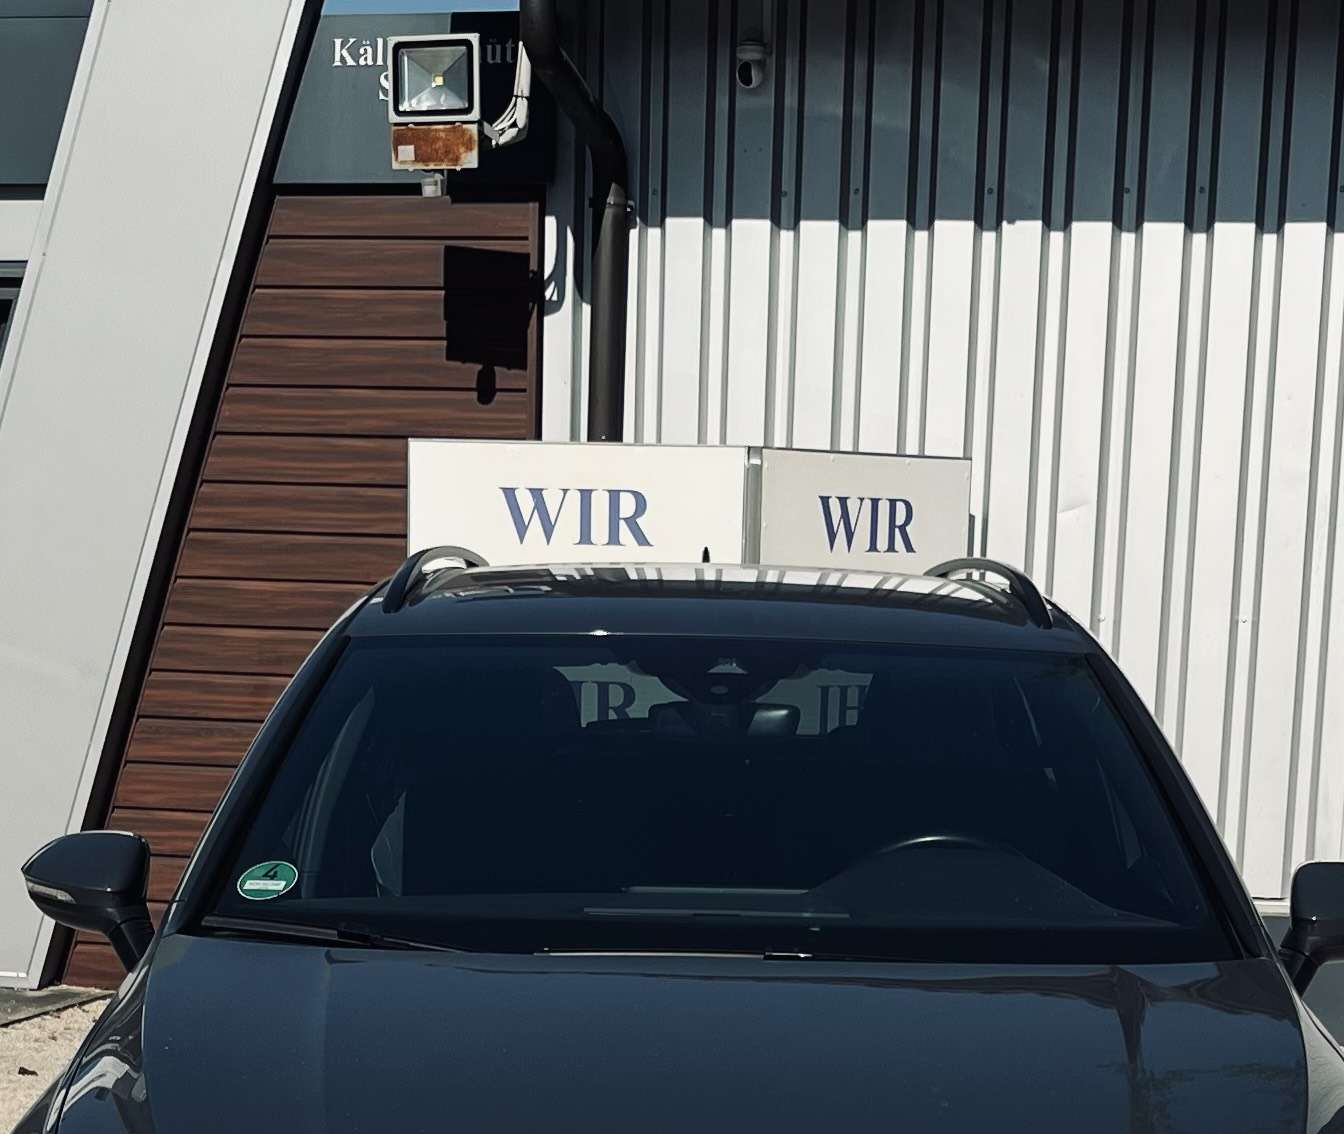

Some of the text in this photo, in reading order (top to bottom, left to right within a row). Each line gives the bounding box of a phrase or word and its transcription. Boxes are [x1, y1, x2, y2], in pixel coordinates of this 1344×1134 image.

[499, 486, 655, 548] WIR
[818, 495, 917, 554] WIR
[261, 862, 280, 880] 4
